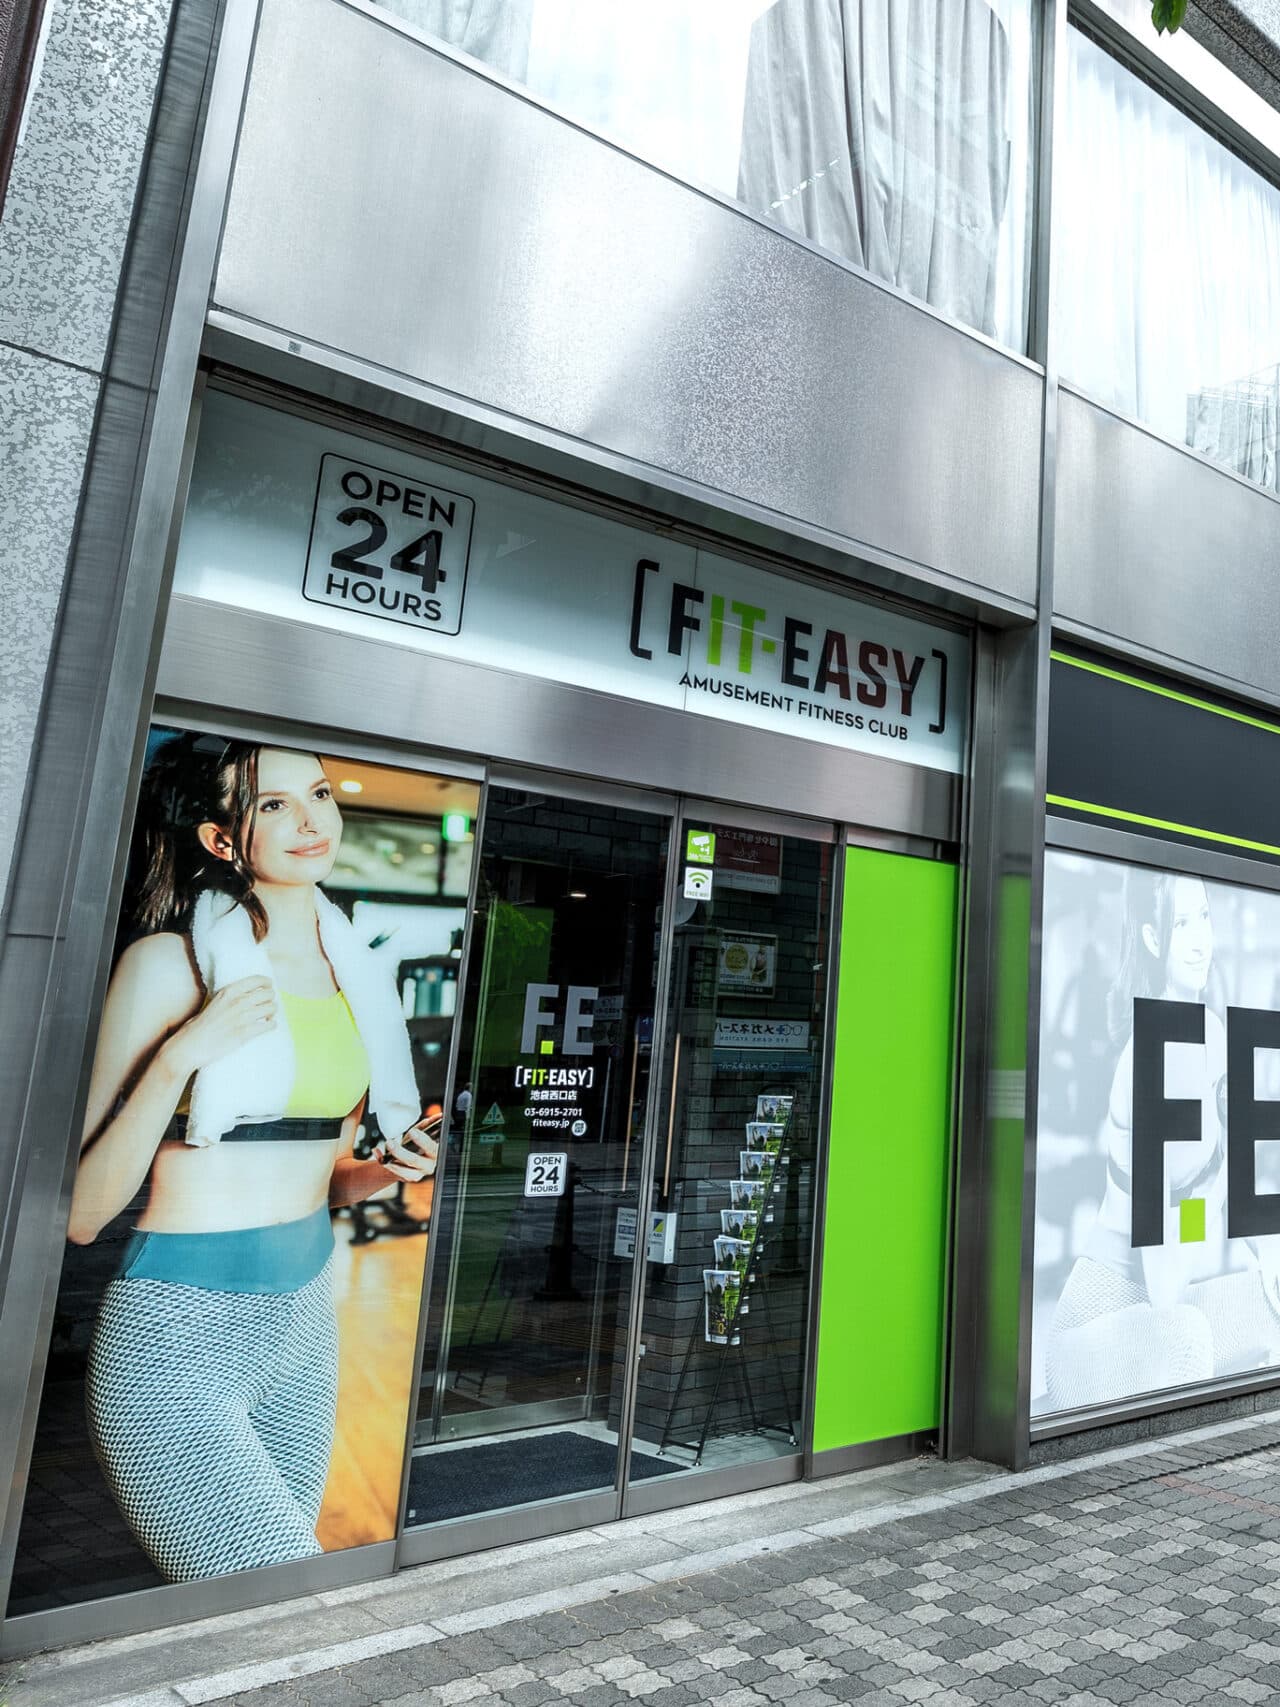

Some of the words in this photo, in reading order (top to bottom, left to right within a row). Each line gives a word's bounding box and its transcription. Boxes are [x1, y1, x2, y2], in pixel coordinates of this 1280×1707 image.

[341, 471, 456, 528] OPEN
[331, 507, 447, 594] 24
[326, 573, 442, 622] HOURS
[679, 671, 794, 713] AMUSEMENT
[798, 701, 864, 730] FITNESS
[868, 719, 908, 741] CLUB
[524, 1107, 583, 1117] 03-6915-2701
[533, 1118, 570, 1129] fiteasy.jp
[533, 1156, 562, 1165] OPEN
[532, 1166, 560, 1185] 24
[530, 1185, 559, 1193] HOURS
